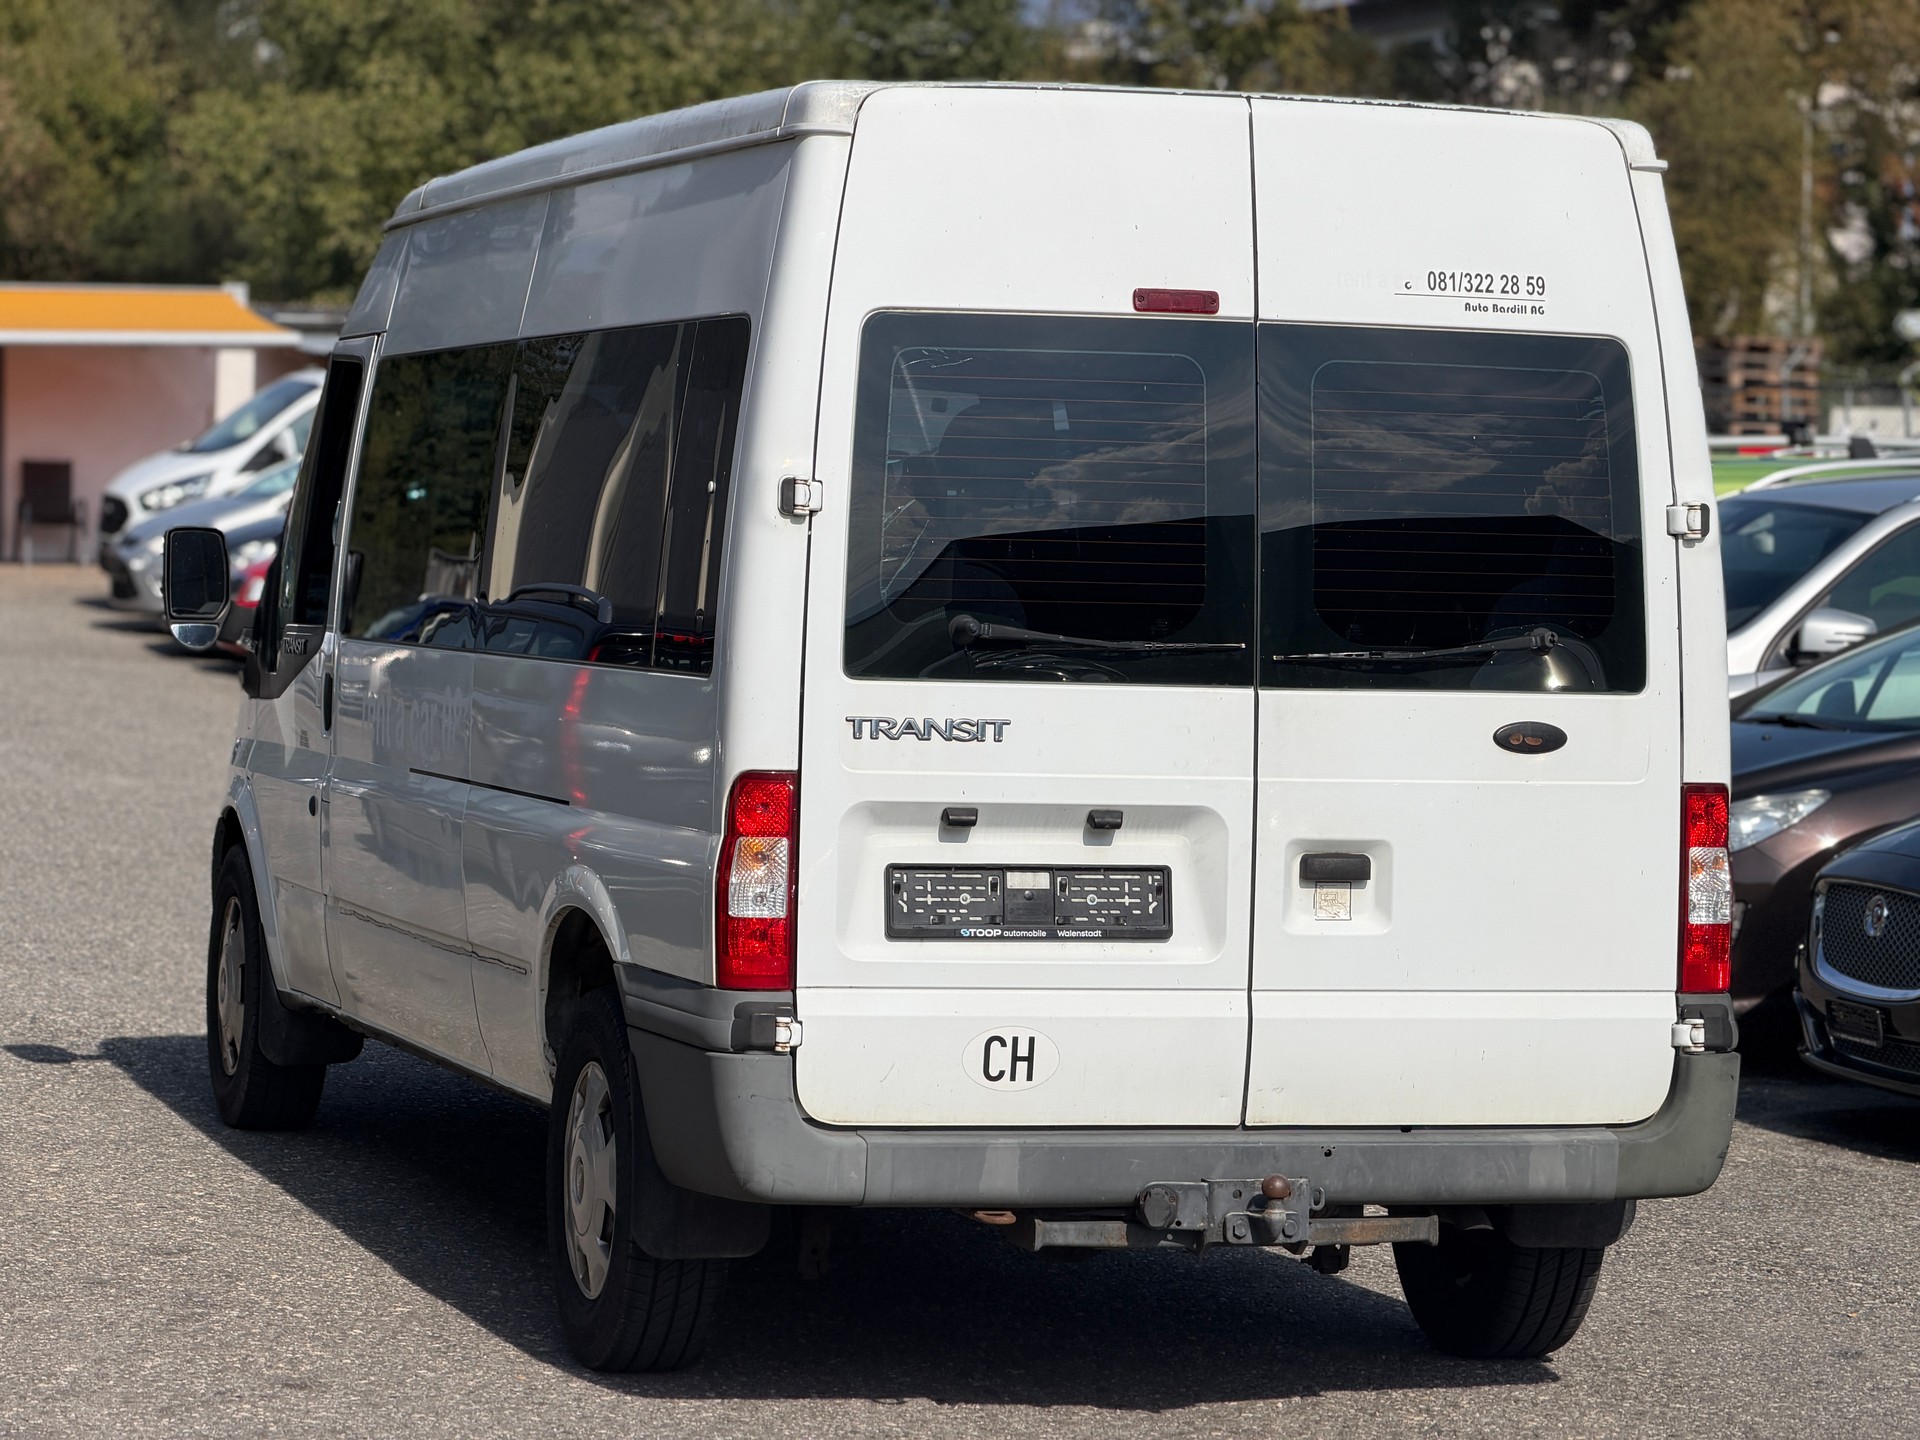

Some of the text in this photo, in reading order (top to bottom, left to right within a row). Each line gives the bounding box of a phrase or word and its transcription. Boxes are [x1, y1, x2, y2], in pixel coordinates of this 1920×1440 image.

[1427, 270, 1546, 297] 081/322 28 59
[1464, 302, 1546, 317] Auto Bardill AG
[845, 715, 1012, 742] TRANSIT
[1003, 928, 1047, 938] automobile
[1057, 928, 1103, 939] Walenstadt
[982, 1035, 1036, 1083] CH
